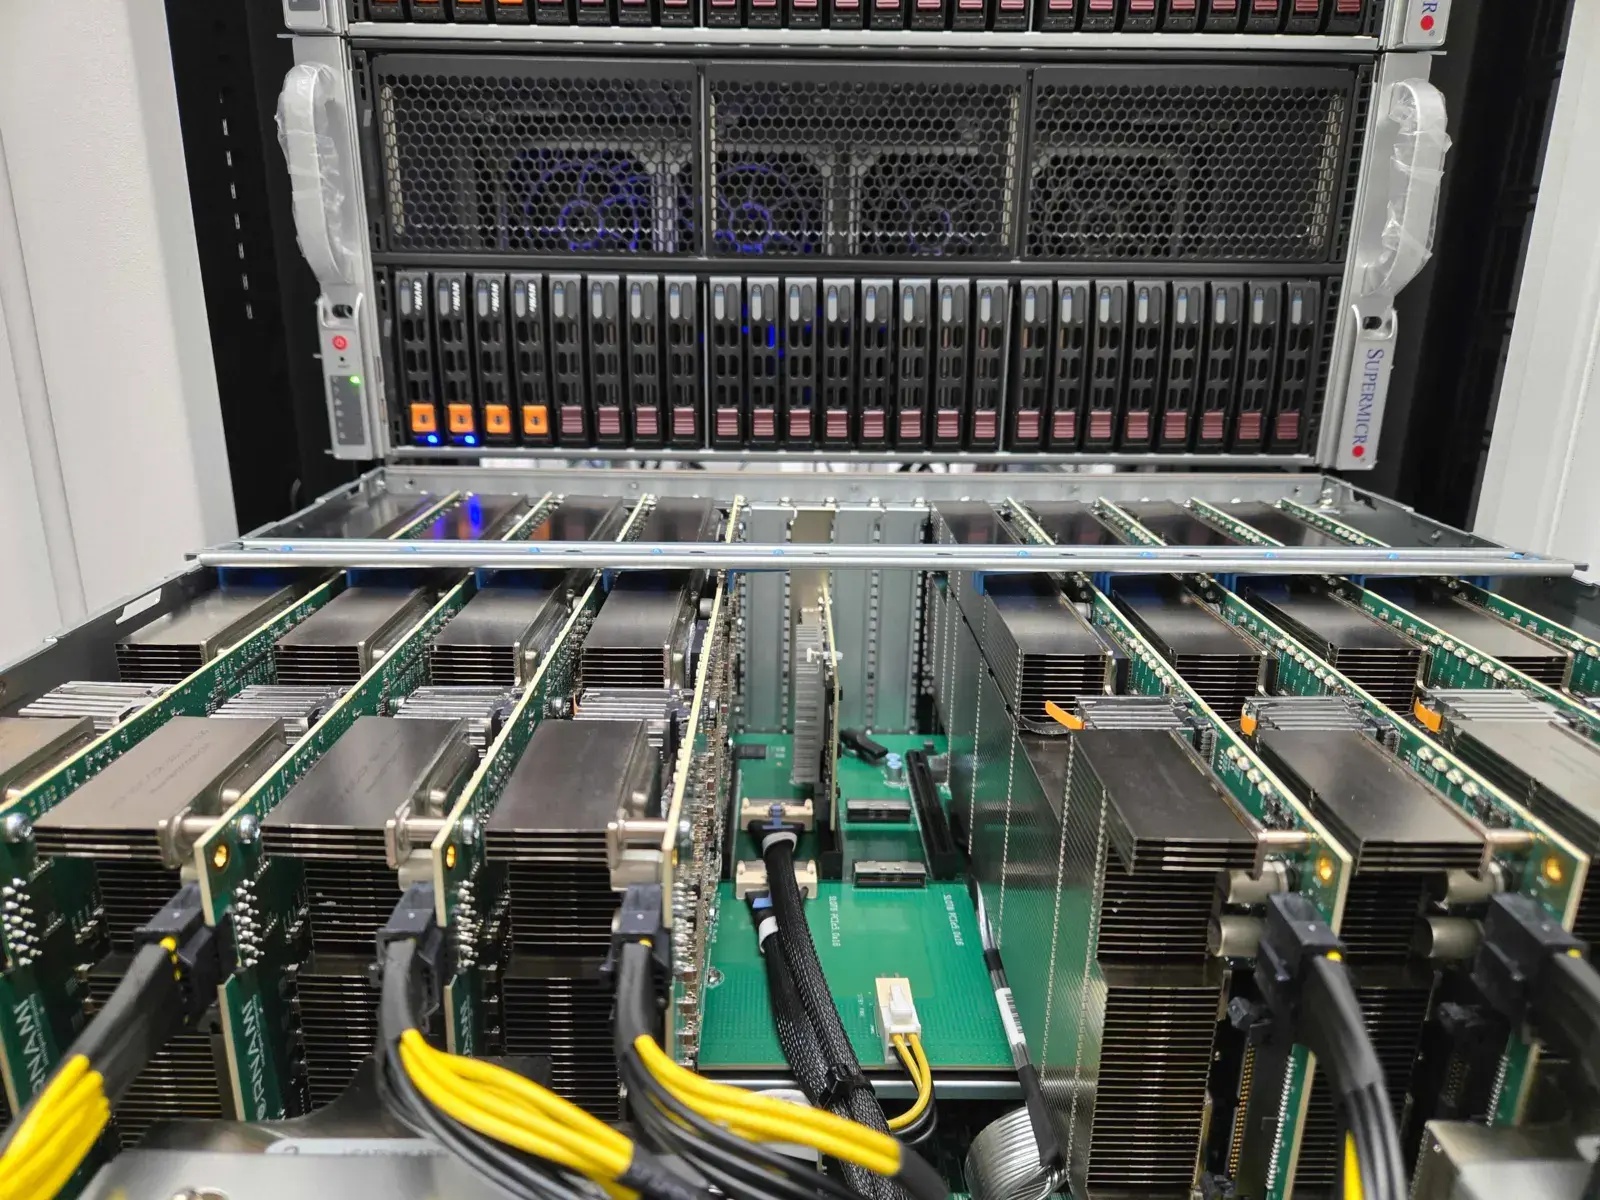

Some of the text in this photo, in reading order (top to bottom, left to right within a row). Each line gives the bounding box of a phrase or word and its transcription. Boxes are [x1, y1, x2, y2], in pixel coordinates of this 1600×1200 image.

[414, 281, 422, 311] NVMe
[452, 281, 460, 311] NVMe
[491, 282, 499, 312] NVMe
[528, 282, 537, 313] NVMe
